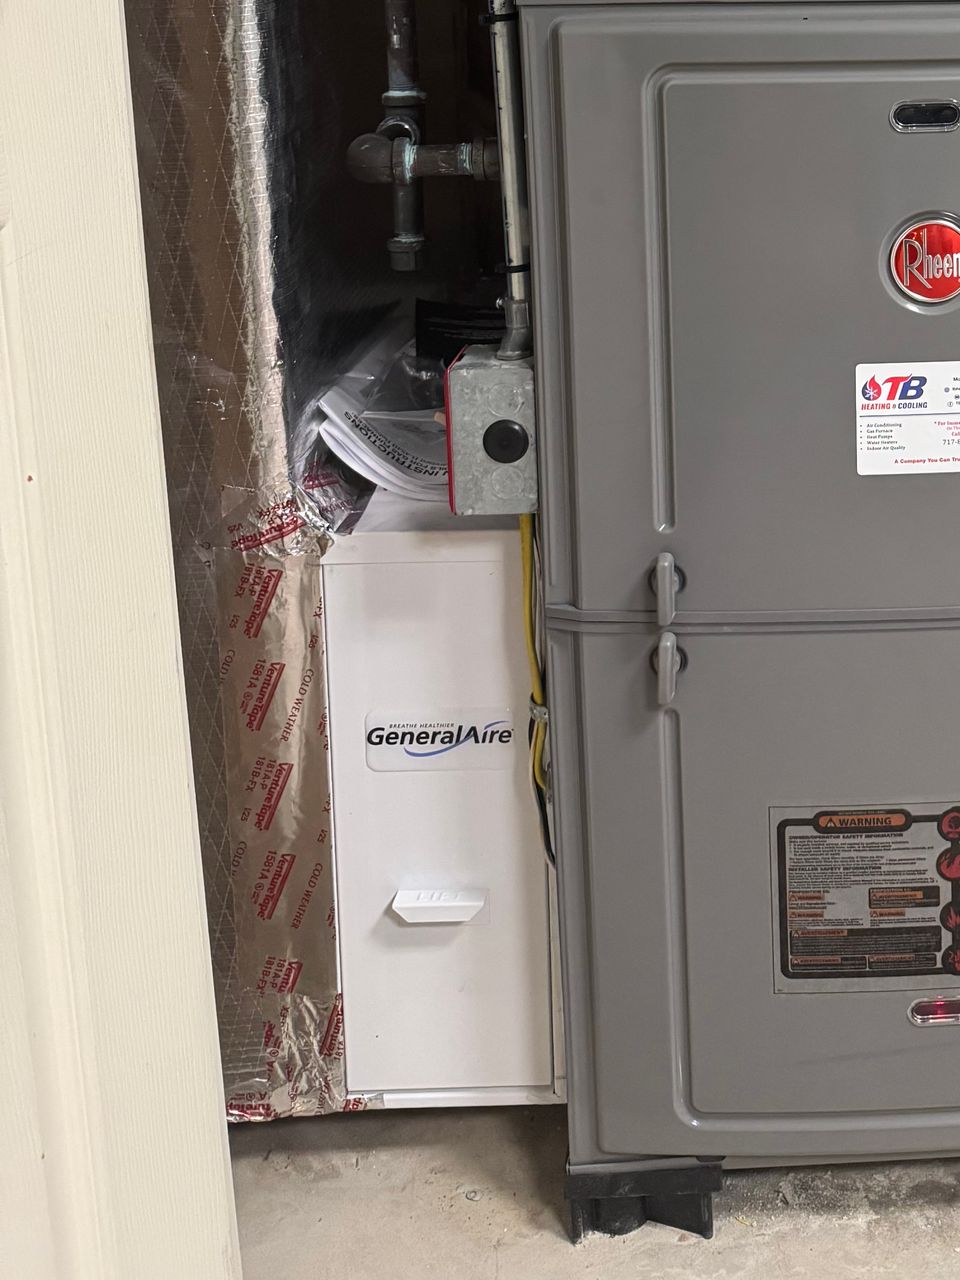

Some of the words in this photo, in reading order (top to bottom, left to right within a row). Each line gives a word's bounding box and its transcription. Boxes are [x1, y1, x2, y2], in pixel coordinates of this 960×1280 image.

[882, 373, 928, 401] TB
[861, 403, 891, 411] HEATING
[898, 401, 928, 410] COOLING
[343, 411, 440, 476] INSTRUCTIONS
[243, 568, 277, 638] VentureTape
[220, 649, 235, 678] COLD
[249, 658, 266, 689] 1581A
[245, 660, 281, 732] VentureTape
[298, 668, 314, 696] COLD
[280, 697, 301, 742] WEATHER
[366, 724, 512, 746] GeneralAire
[245, 755, 266, 792] 181B-FX
[260, 758, 277, 790] 181A-P
[253, 761, 290, 831] VentureTape
[839, 816, 892, 827] WARNING
[231, 840, 248, 868] COLD
[258, 849, 277, 880] 1581A
[256, 852, 292, 921] VentureTape
[307, 862, 324, 889] COLD
[290, 889, 312, 930] WEATHER
[269, 958, 287, 989] 181A-P
